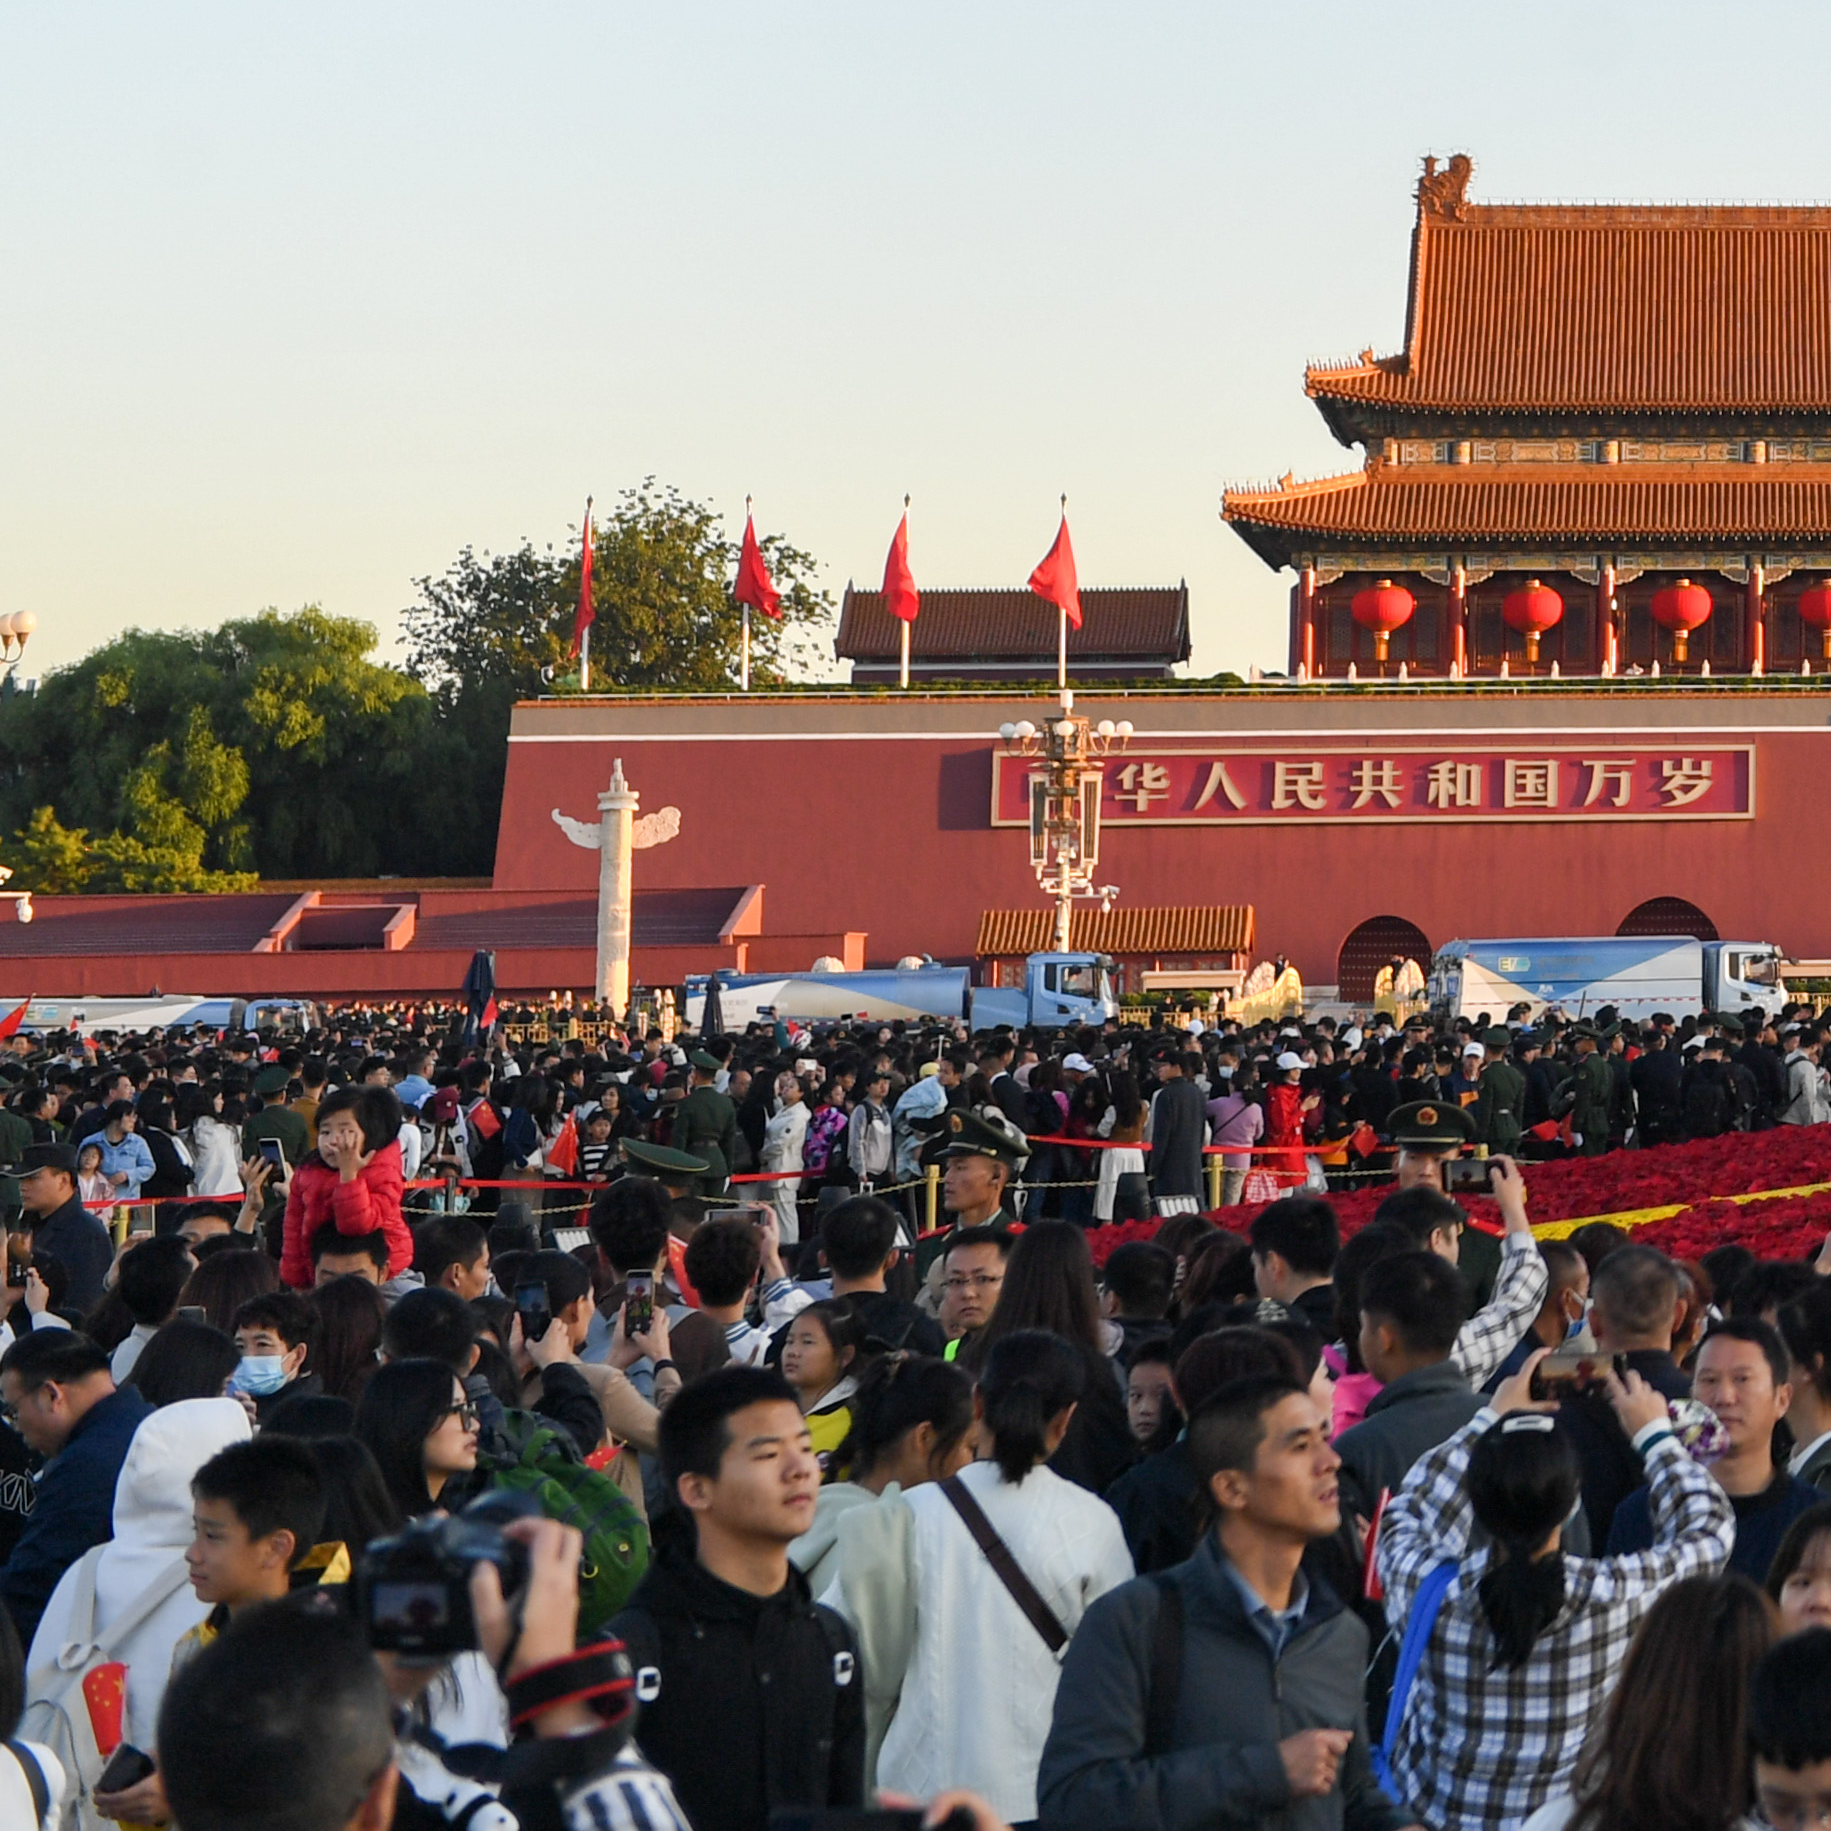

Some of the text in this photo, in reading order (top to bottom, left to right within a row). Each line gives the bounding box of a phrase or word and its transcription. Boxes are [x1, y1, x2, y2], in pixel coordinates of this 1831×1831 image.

[1114, 758, 1714, 812] 华人民共和国万岁
